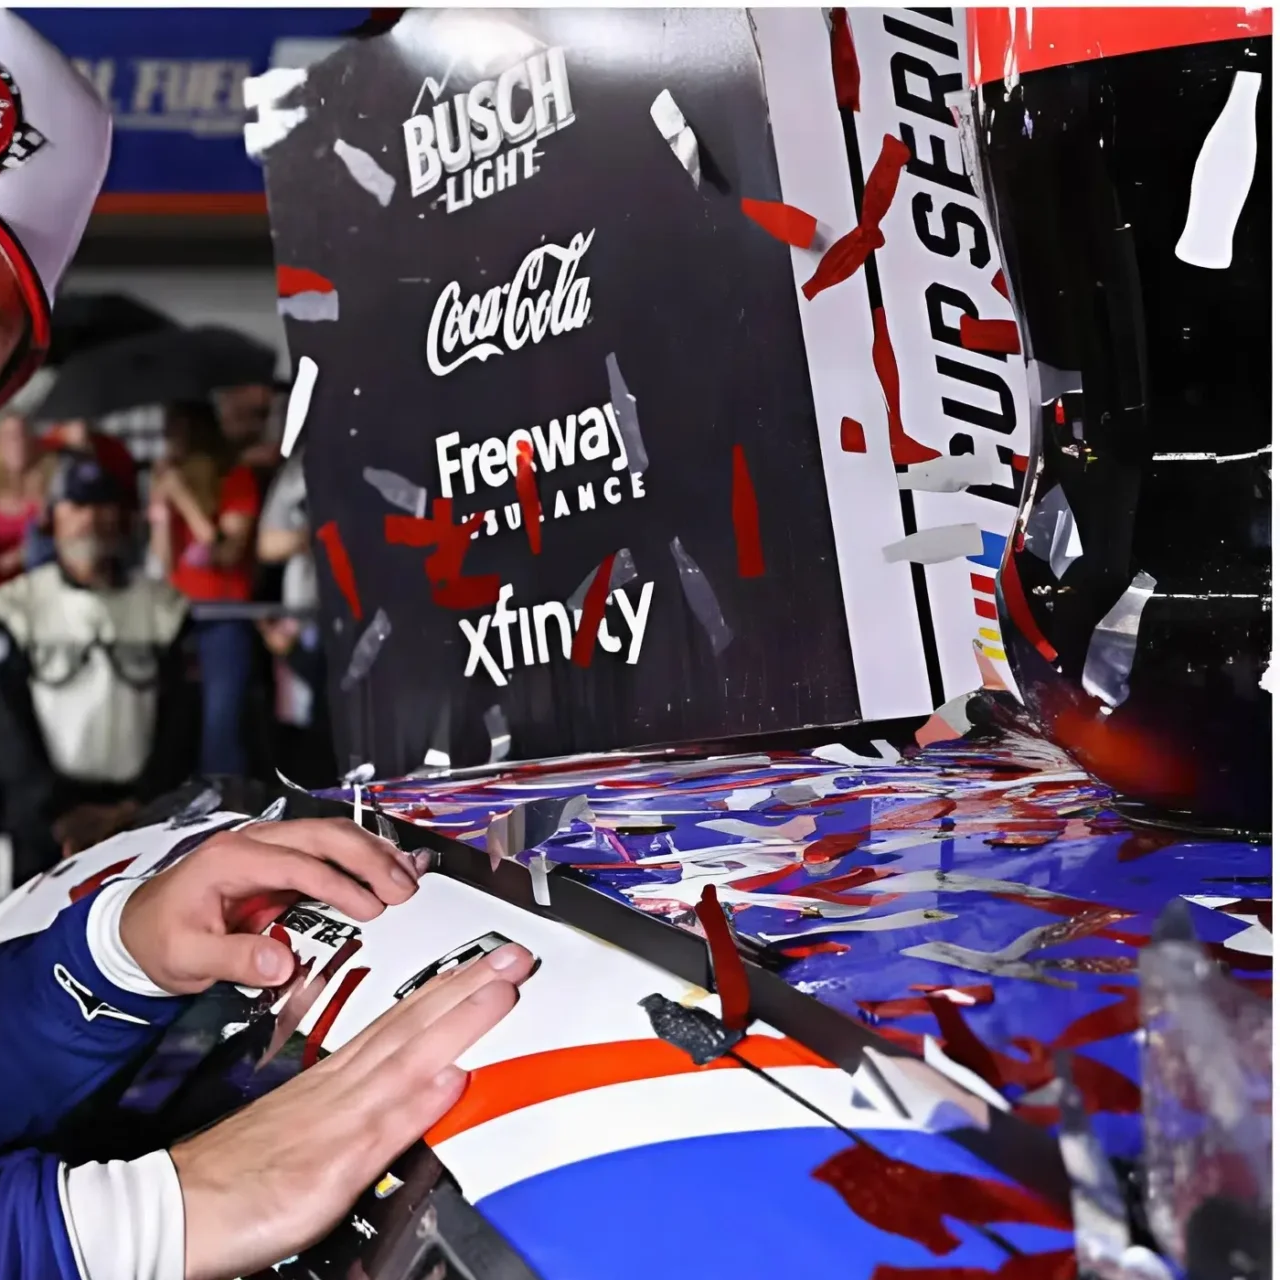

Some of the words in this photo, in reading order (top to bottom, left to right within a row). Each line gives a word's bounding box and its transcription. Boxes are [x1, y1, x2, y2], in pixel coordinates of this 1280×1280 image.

[402, 46, 576, 197] BUSCH
[445, 140, 545, 213] LIGHT
[882, 7, 993, 270] SERI
[426, 228, 596, 376] Coca-Cola
[458, 581, 655, 687] xfinty
